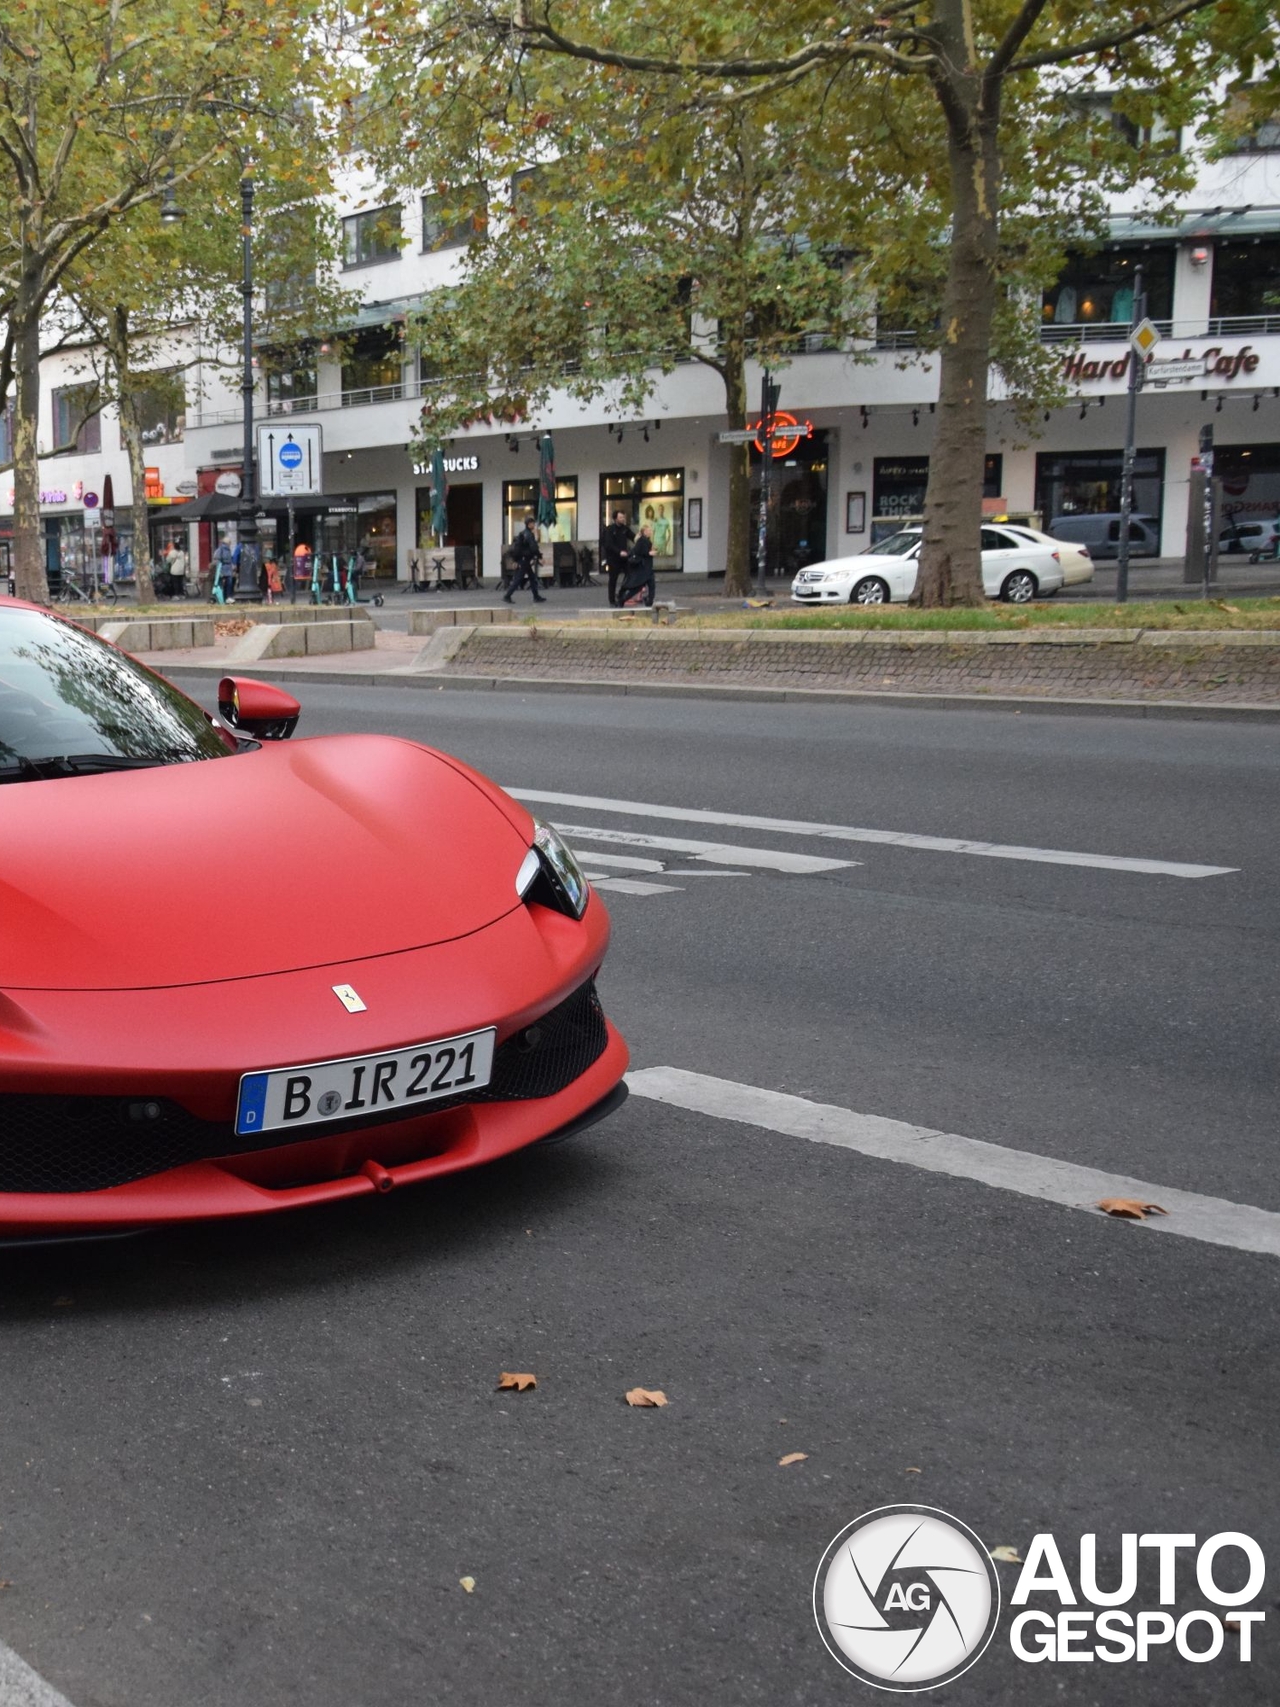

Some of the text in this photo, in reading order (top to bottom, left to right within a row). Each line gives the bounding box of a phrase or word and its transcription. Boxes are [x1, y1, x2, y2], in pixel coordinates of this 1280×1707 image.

[1065, 352, 1131, 380] Hard
[1205, 346, 1260, 380] Cafe
[1148, 363, 1203, 375] Kurfürstendamm
[879, 495, 918, 505] ROCK
[246, 1042, 476, 1124] D B IR 221
